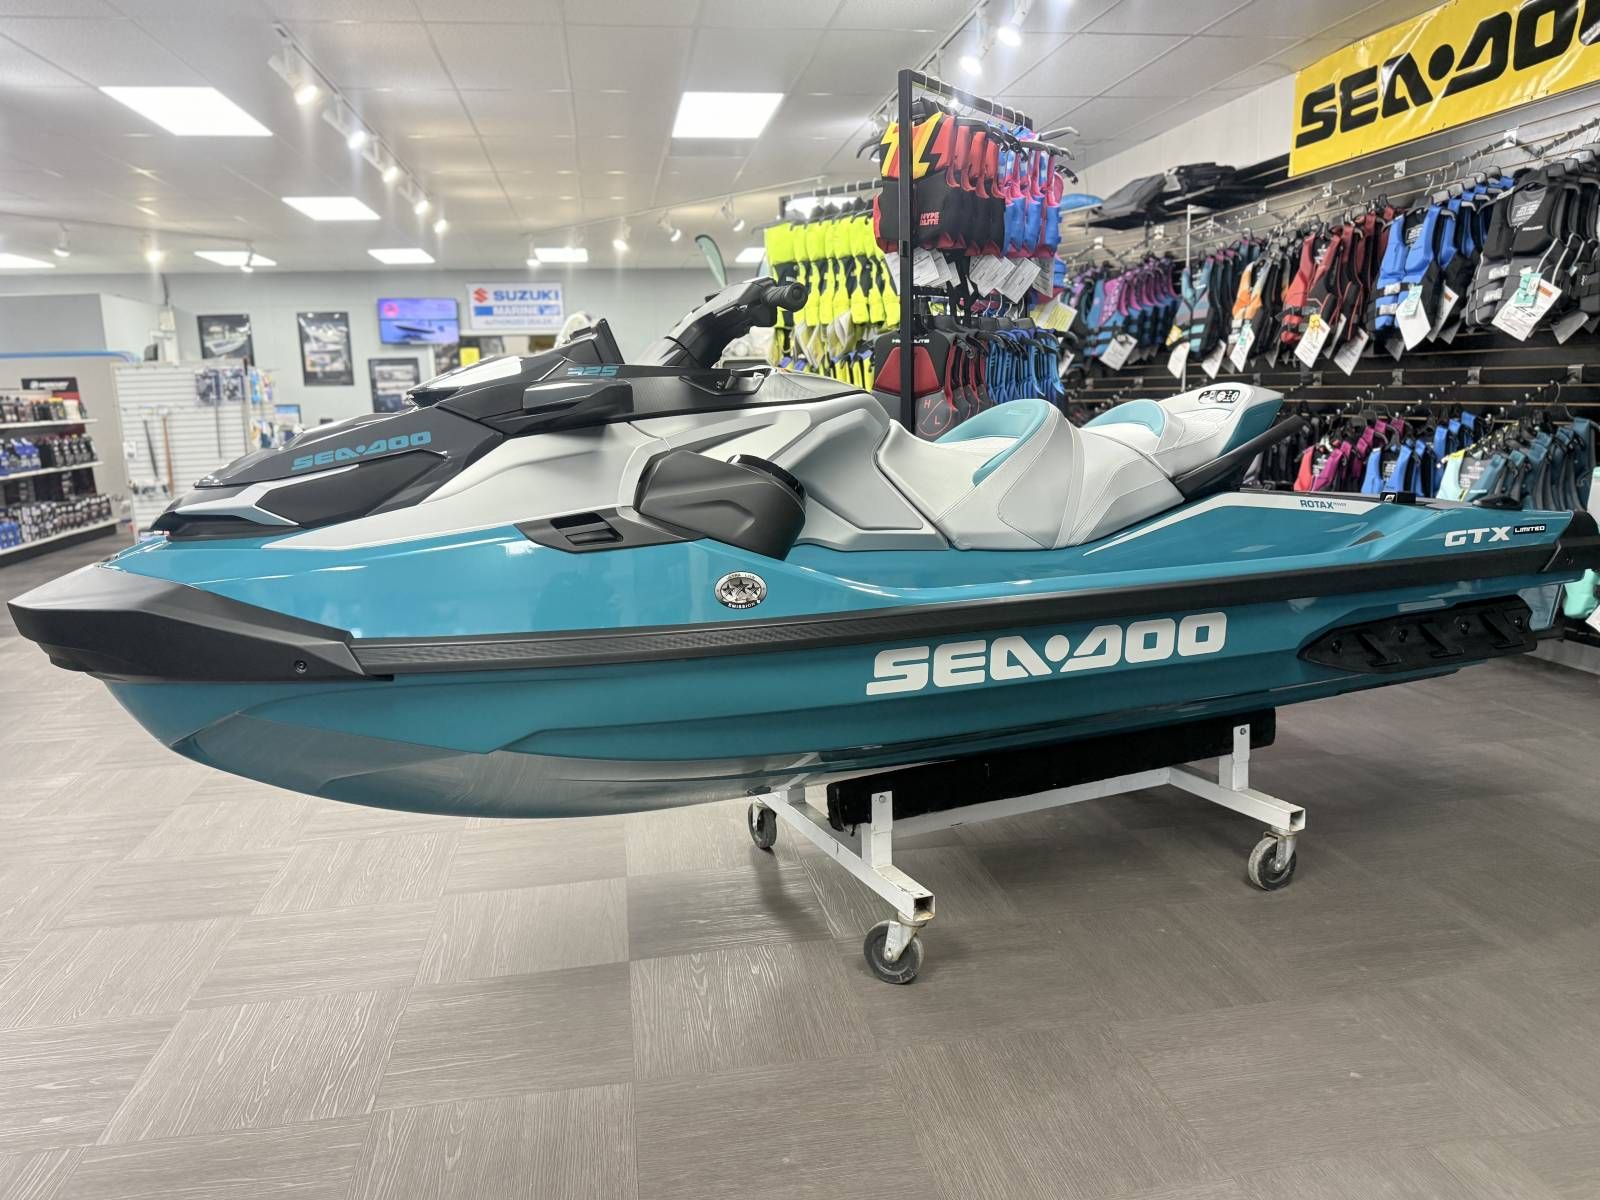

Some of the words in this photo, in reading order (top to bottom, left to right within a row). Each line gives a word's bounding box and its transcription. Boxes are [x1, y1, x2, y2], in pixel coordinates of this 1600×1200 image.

[493, 290, 559, 301] SUZUKI
[568, 365, 619, 376] 325
[1300, 500, 1335, 510] ROTAX
[1444, 526, 1511, 547] GTX
[1514, 525, 1546, 533] LIMITED
